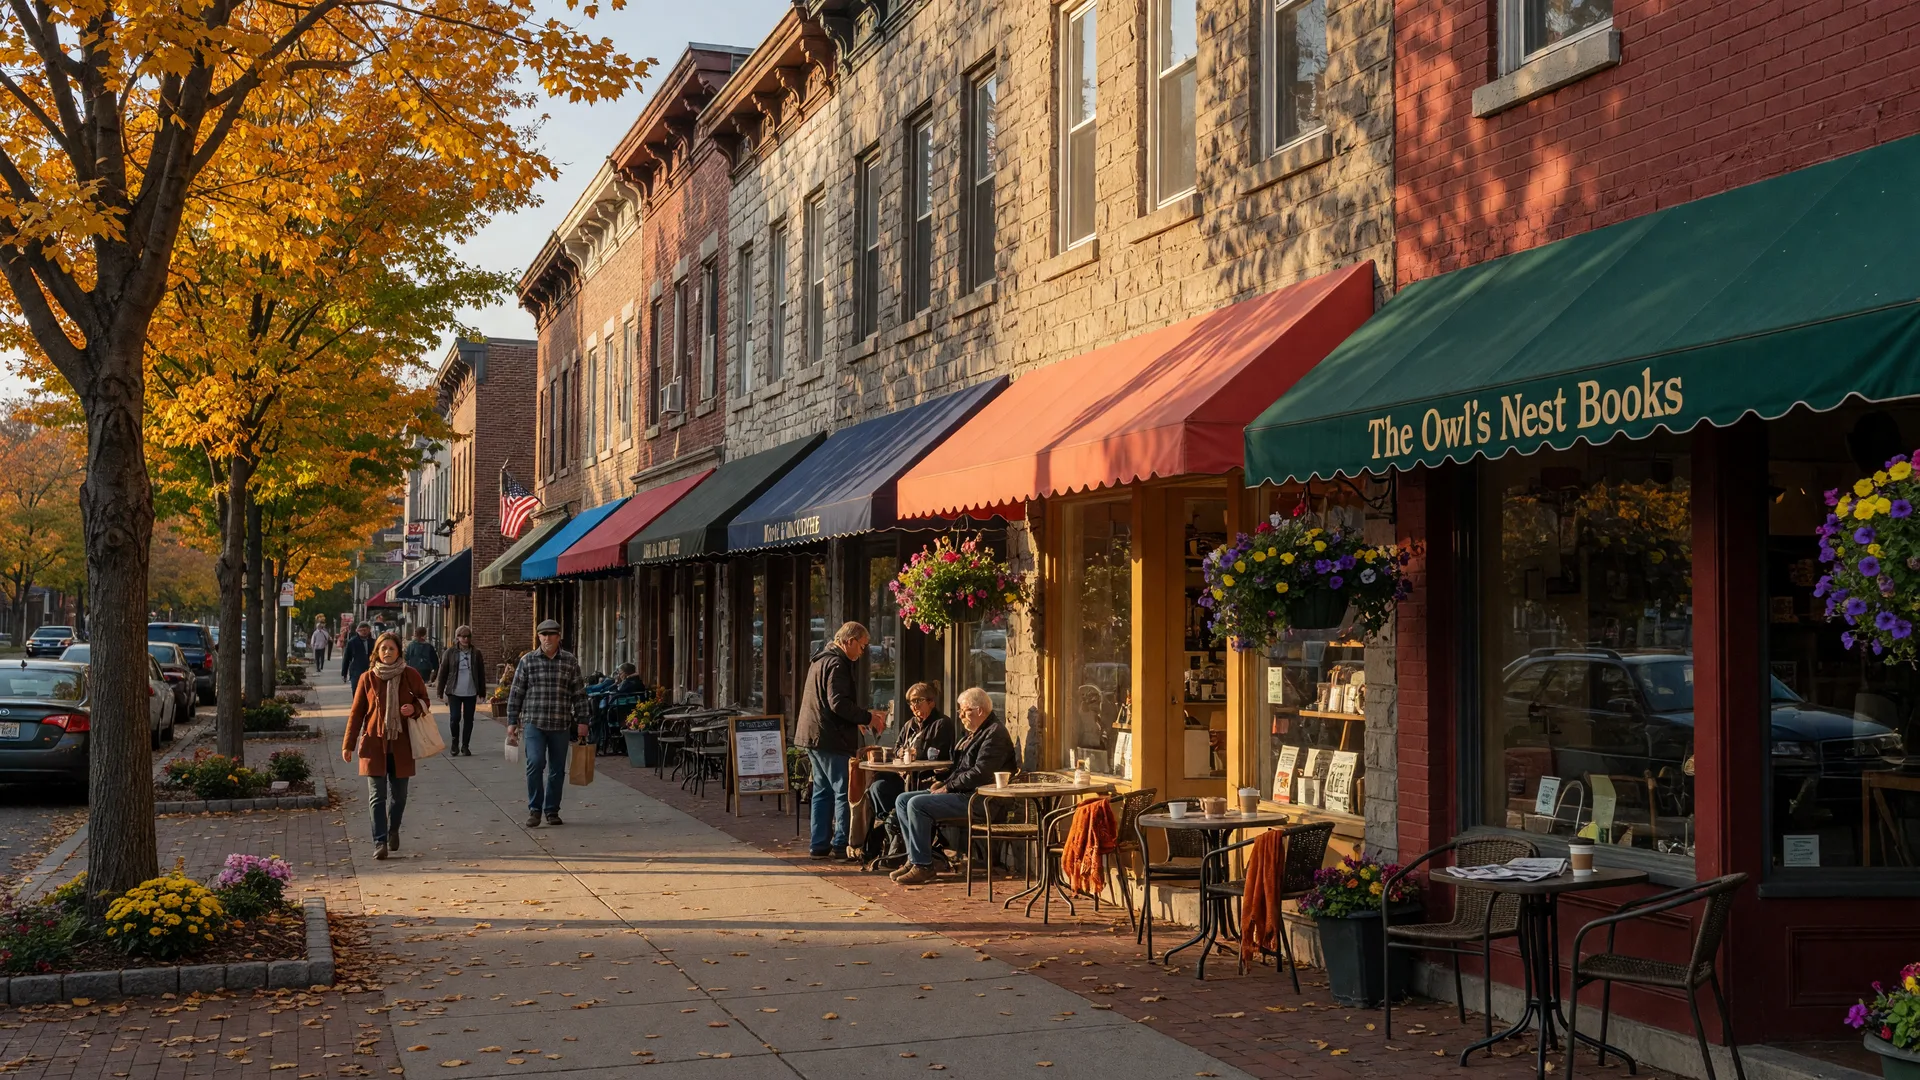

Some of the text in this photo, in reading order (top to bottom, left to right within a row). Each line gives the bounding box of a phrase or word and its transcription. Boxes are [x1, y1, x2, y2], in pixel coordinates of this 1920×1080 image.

[1368, 366, 1684, 459] The Owl's Nest Books
